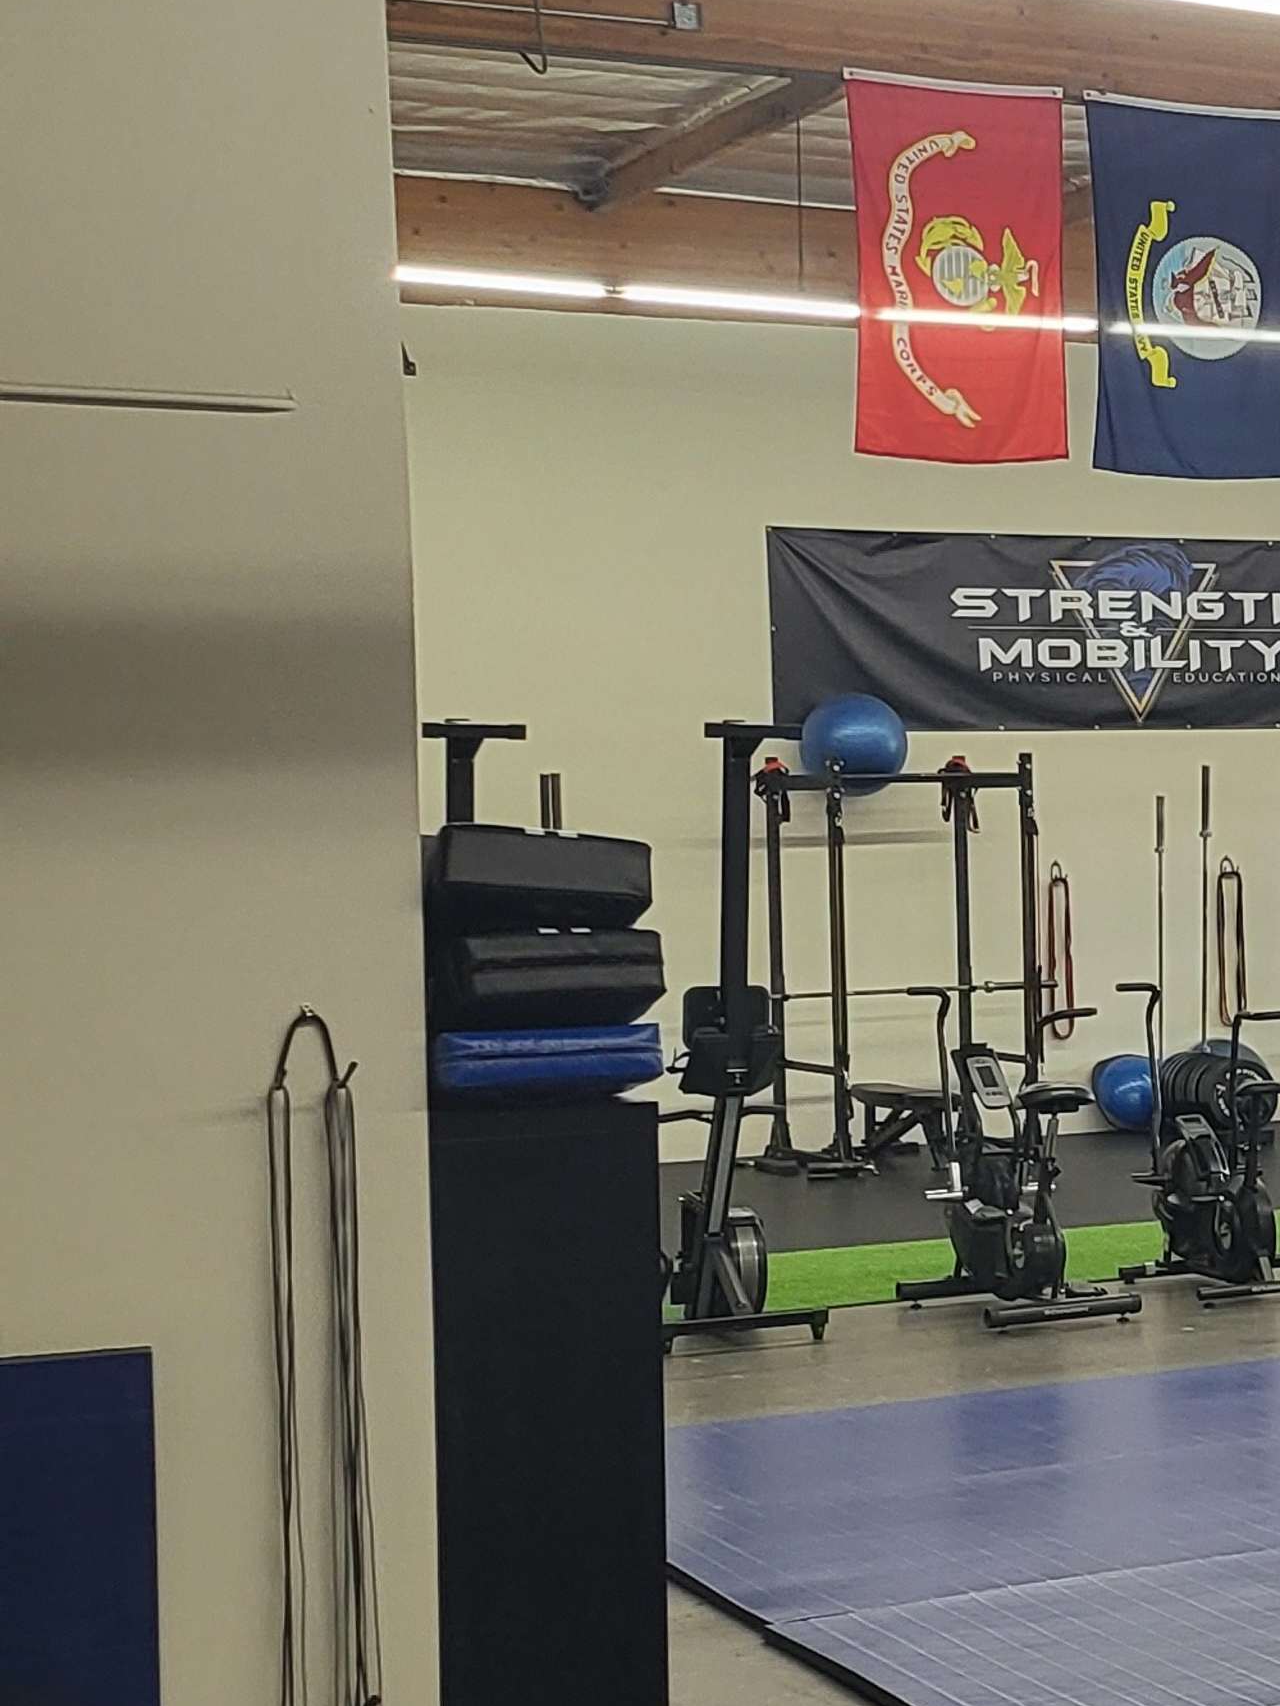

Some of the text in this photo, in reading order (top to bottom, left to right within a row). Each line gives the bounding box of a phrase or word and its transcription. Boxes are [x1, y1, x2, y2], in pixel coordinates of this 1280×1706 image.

[1131, 231, 1150, 272] UNITED
[885, 139, 940, 396] UNITED STATES MARI CORPS
[1119, 621, 1153, 638] &
[992, 671, 1108, 684] PHYSICAL
